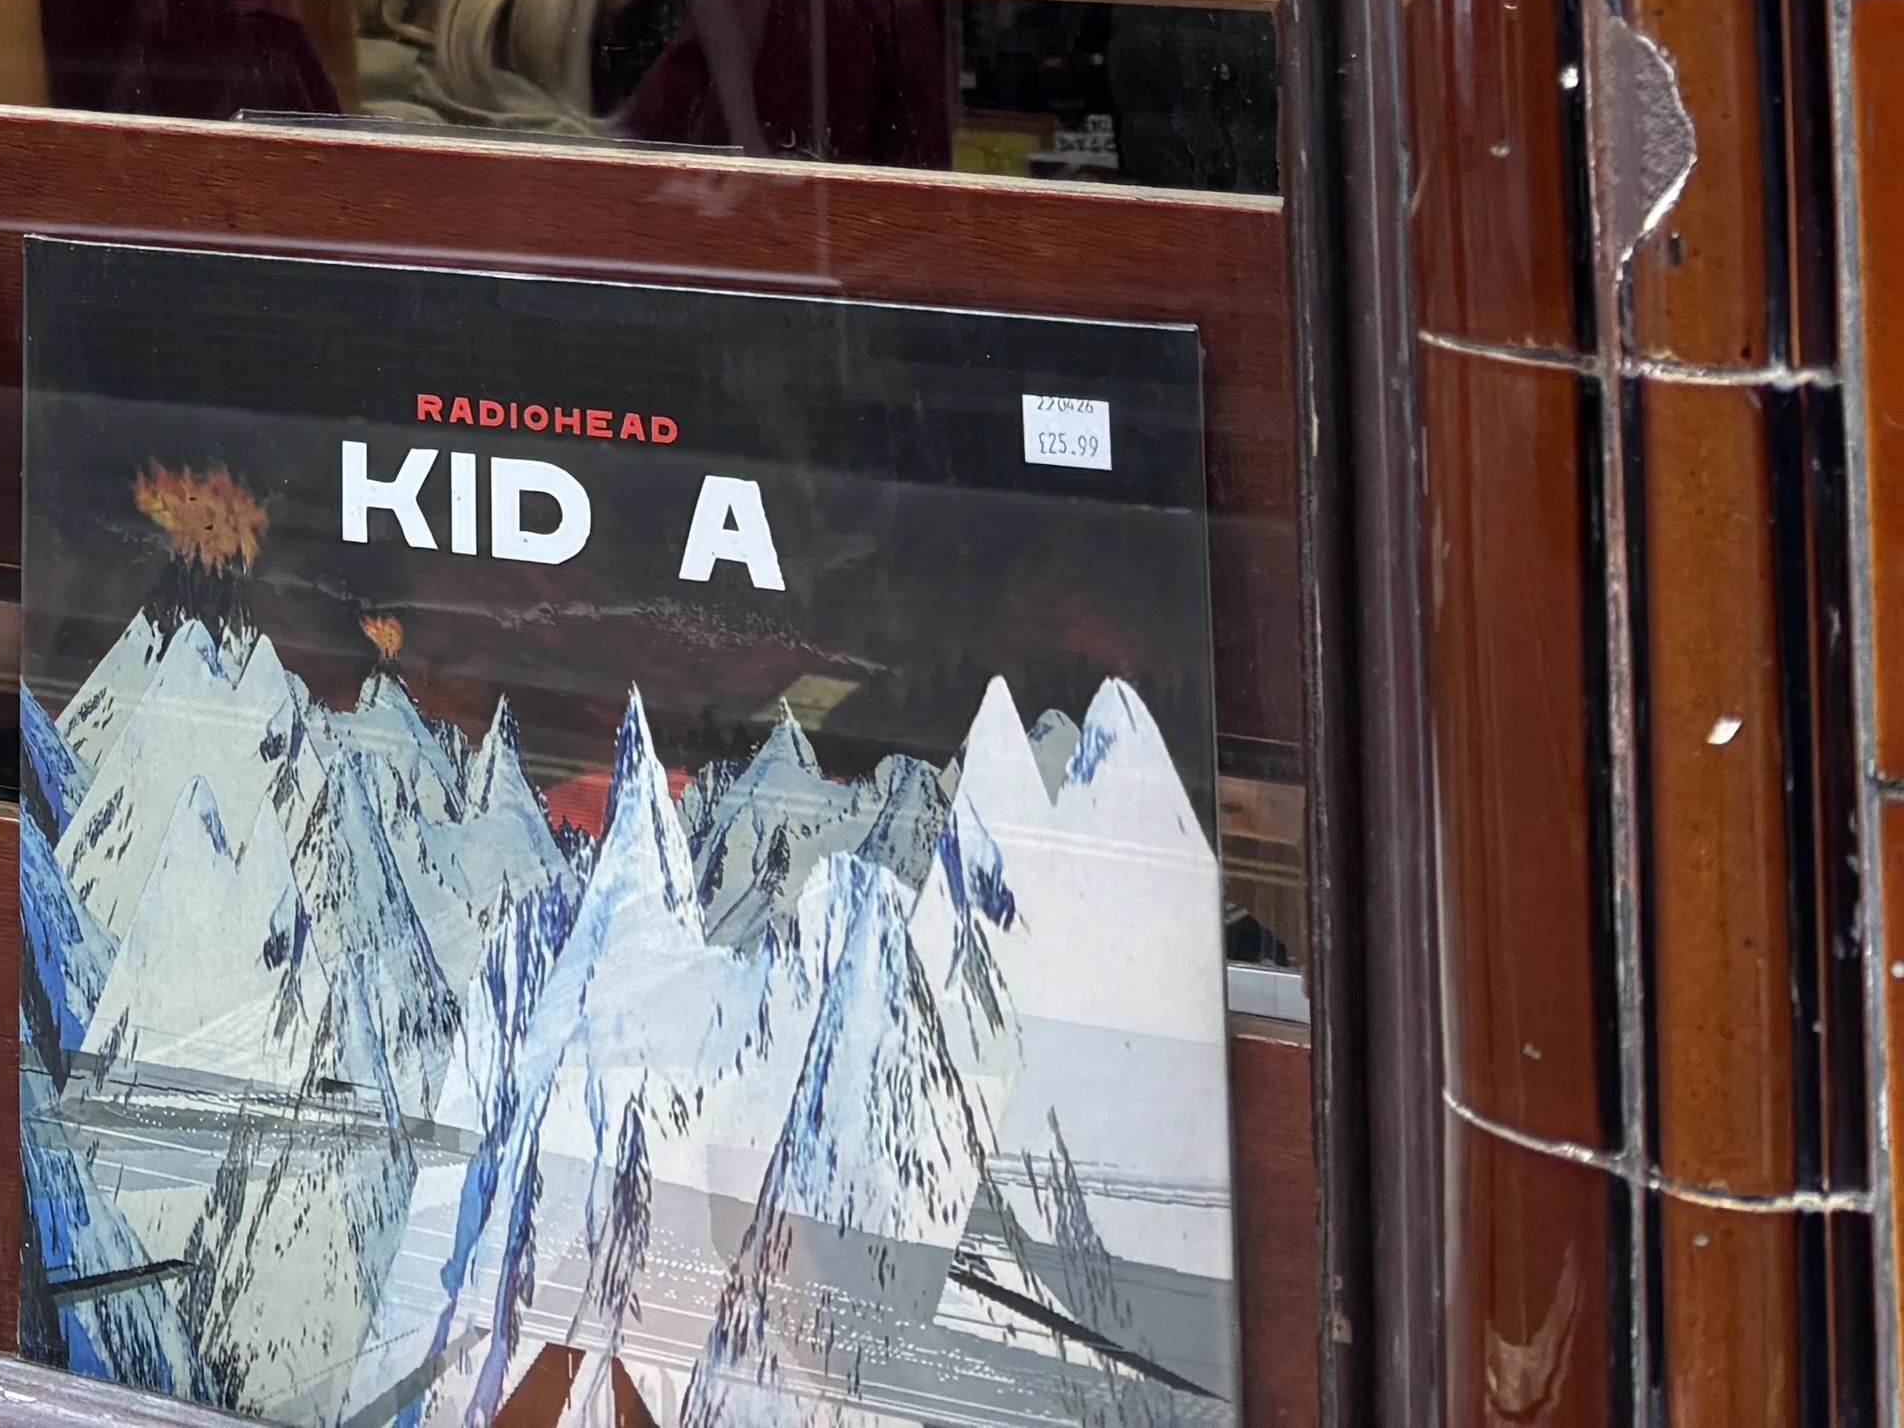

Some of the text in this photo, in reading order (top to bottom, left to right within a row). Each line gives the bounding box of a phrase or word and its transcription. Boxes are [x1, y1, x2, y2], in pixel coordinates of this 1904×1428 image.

[415, 393, 679, 445] RADIOHEAD
[1038, 430, 1100, 459] £25.99
[341, 440, 786, 592] KID A
